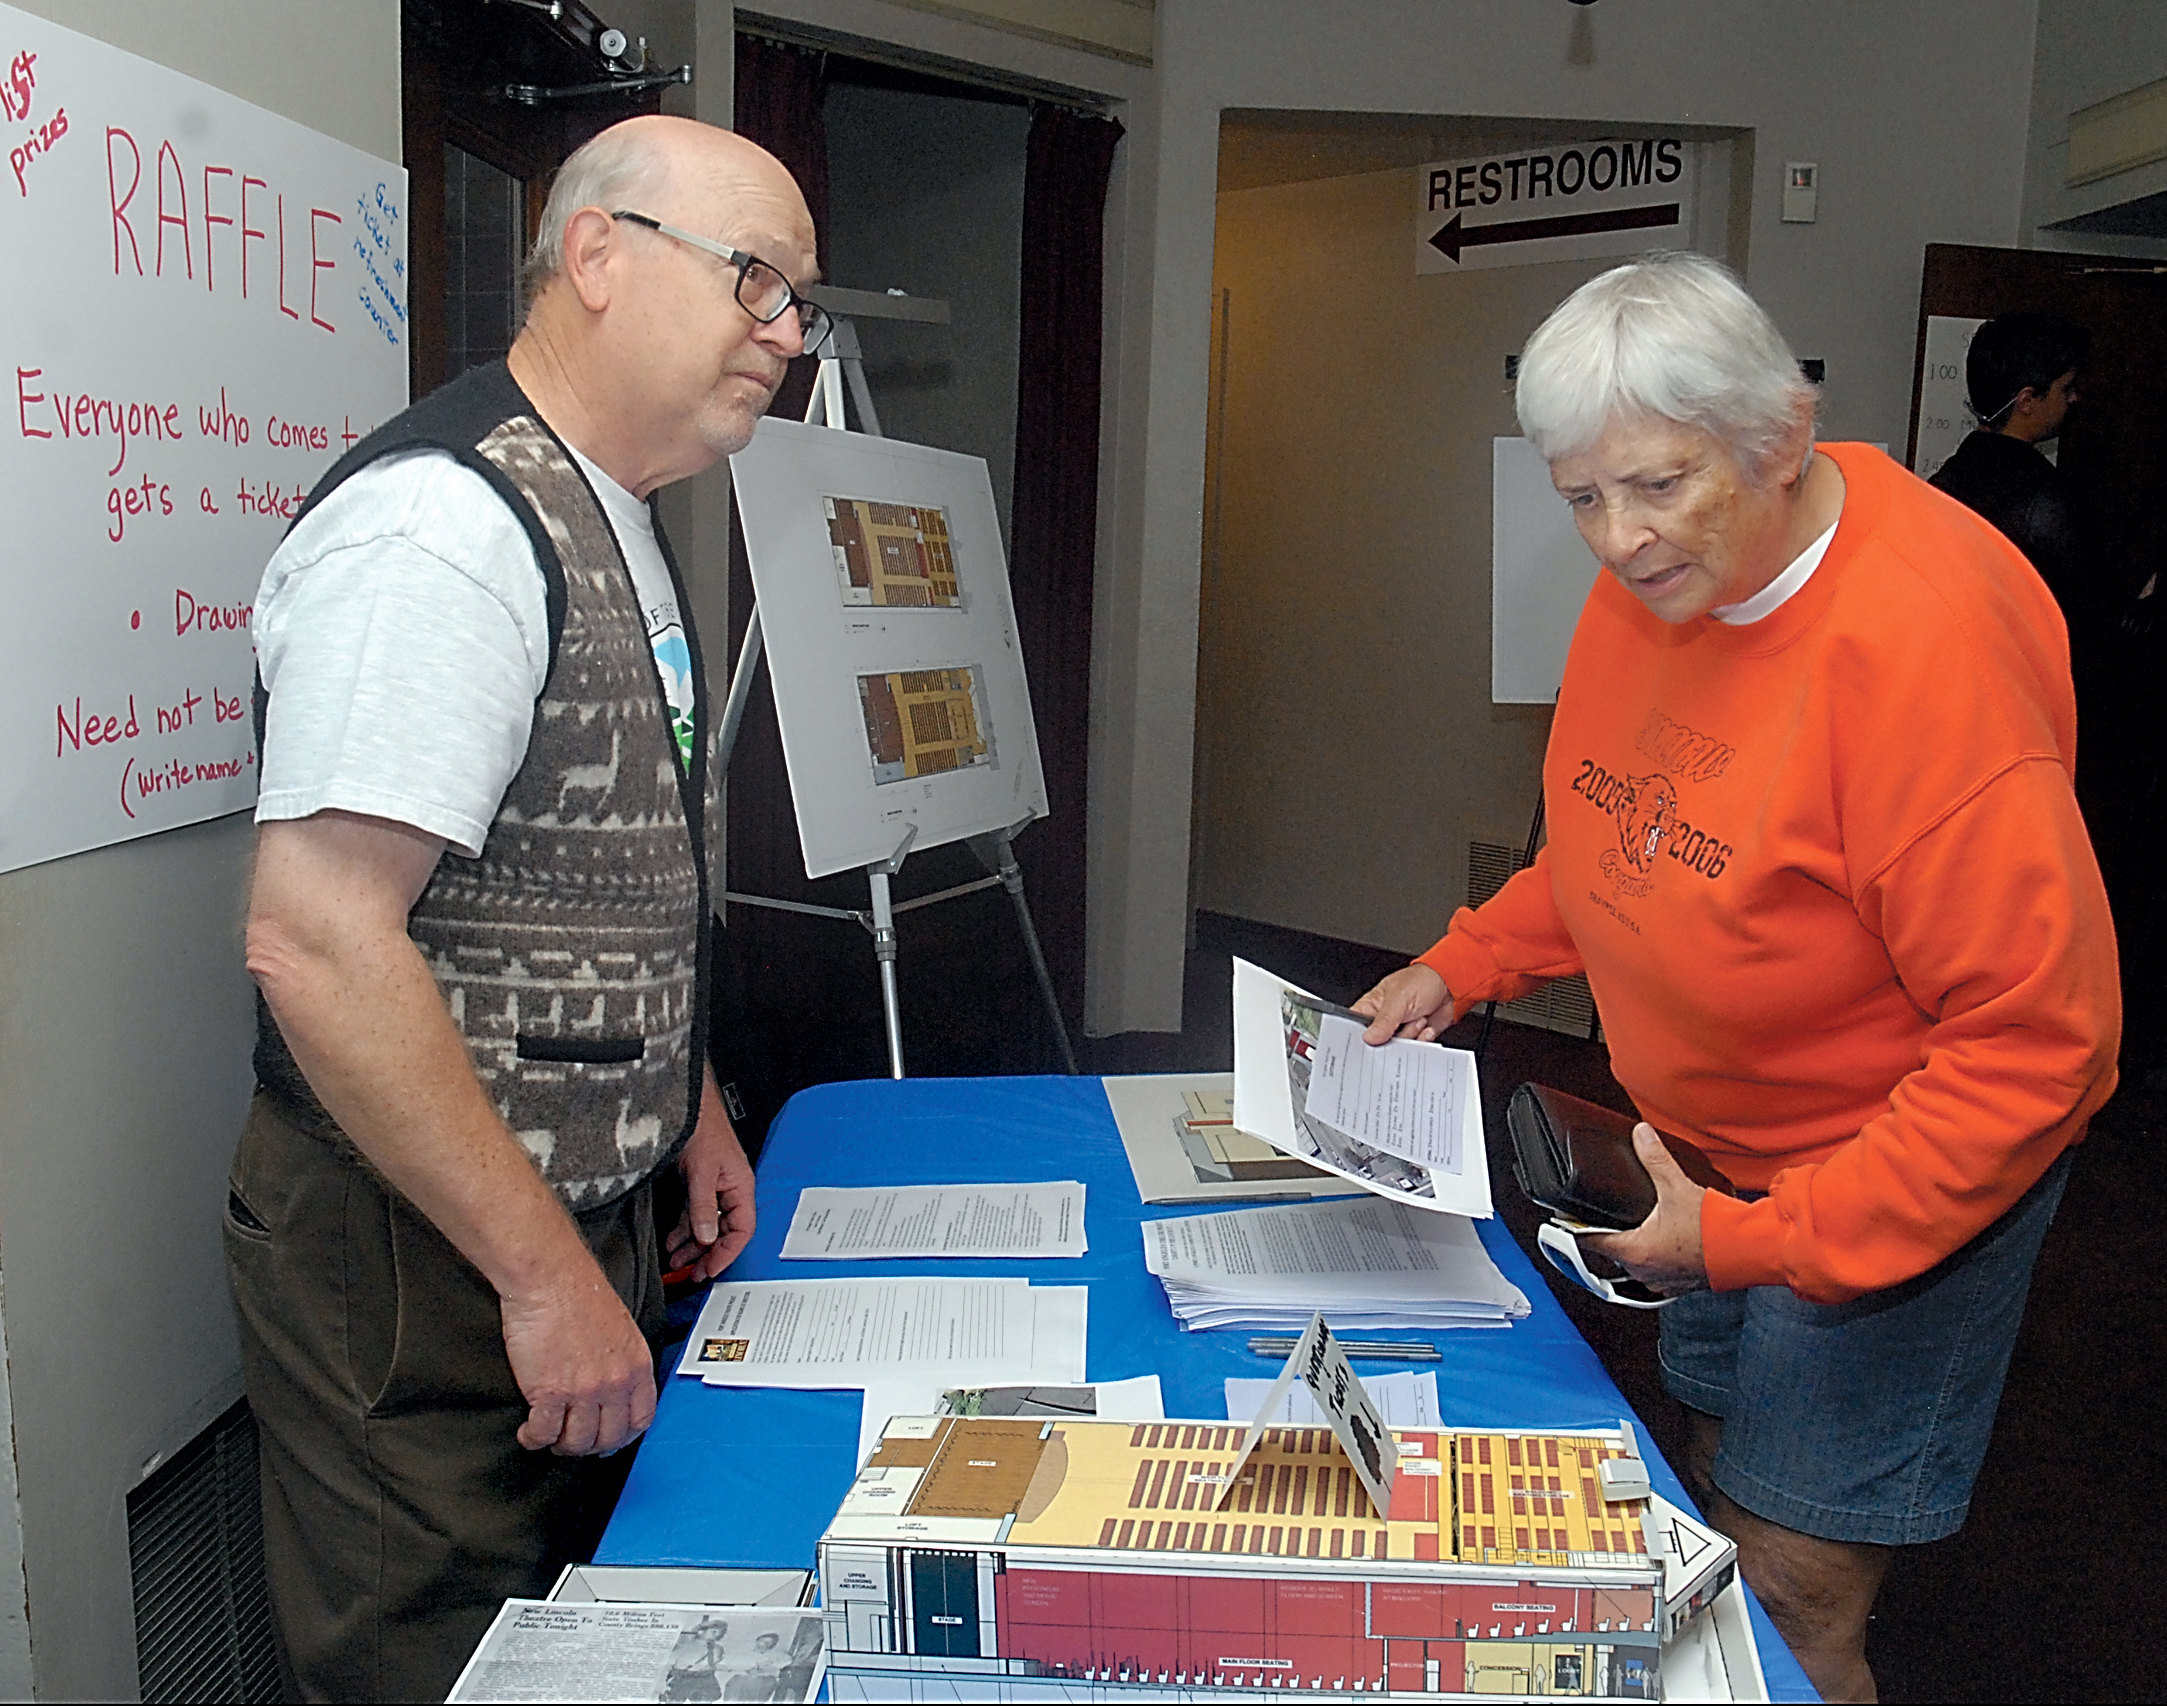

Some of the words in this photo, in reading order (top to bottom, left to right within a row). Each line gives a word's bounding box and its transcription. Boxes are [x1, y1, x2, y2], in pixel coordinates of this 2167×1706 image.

[10, 107, 68, 197] prizes
[1427, 138, 1683, 212] RESTROOMS
[106, 124, 342, 333] RAFFLE
[17, 365, 183, 477] Everyone
[200, 386, 250, 447] who
[267, 415, 328, 452] comes
[107, 473, 173, 543] gets
[200, 492, 219, 515] a
[237, 477, 307, 519] ticket
[57, 694, 140, 758] Need
[157, 688, 202, 735] not
[214, 687, 244, 724] be
[1668, 822, 1733, 880] 2006
[512, 1621, 541, 1629] Public
[544, 1622, 578, 1631] Tonight
[518, 1614, 552, 1622] Theatre
[554, 1615, 578, 1623] Open
[522, 1607, 540, 1615] New
[545, 1608, 577, 1616] Lincoln
